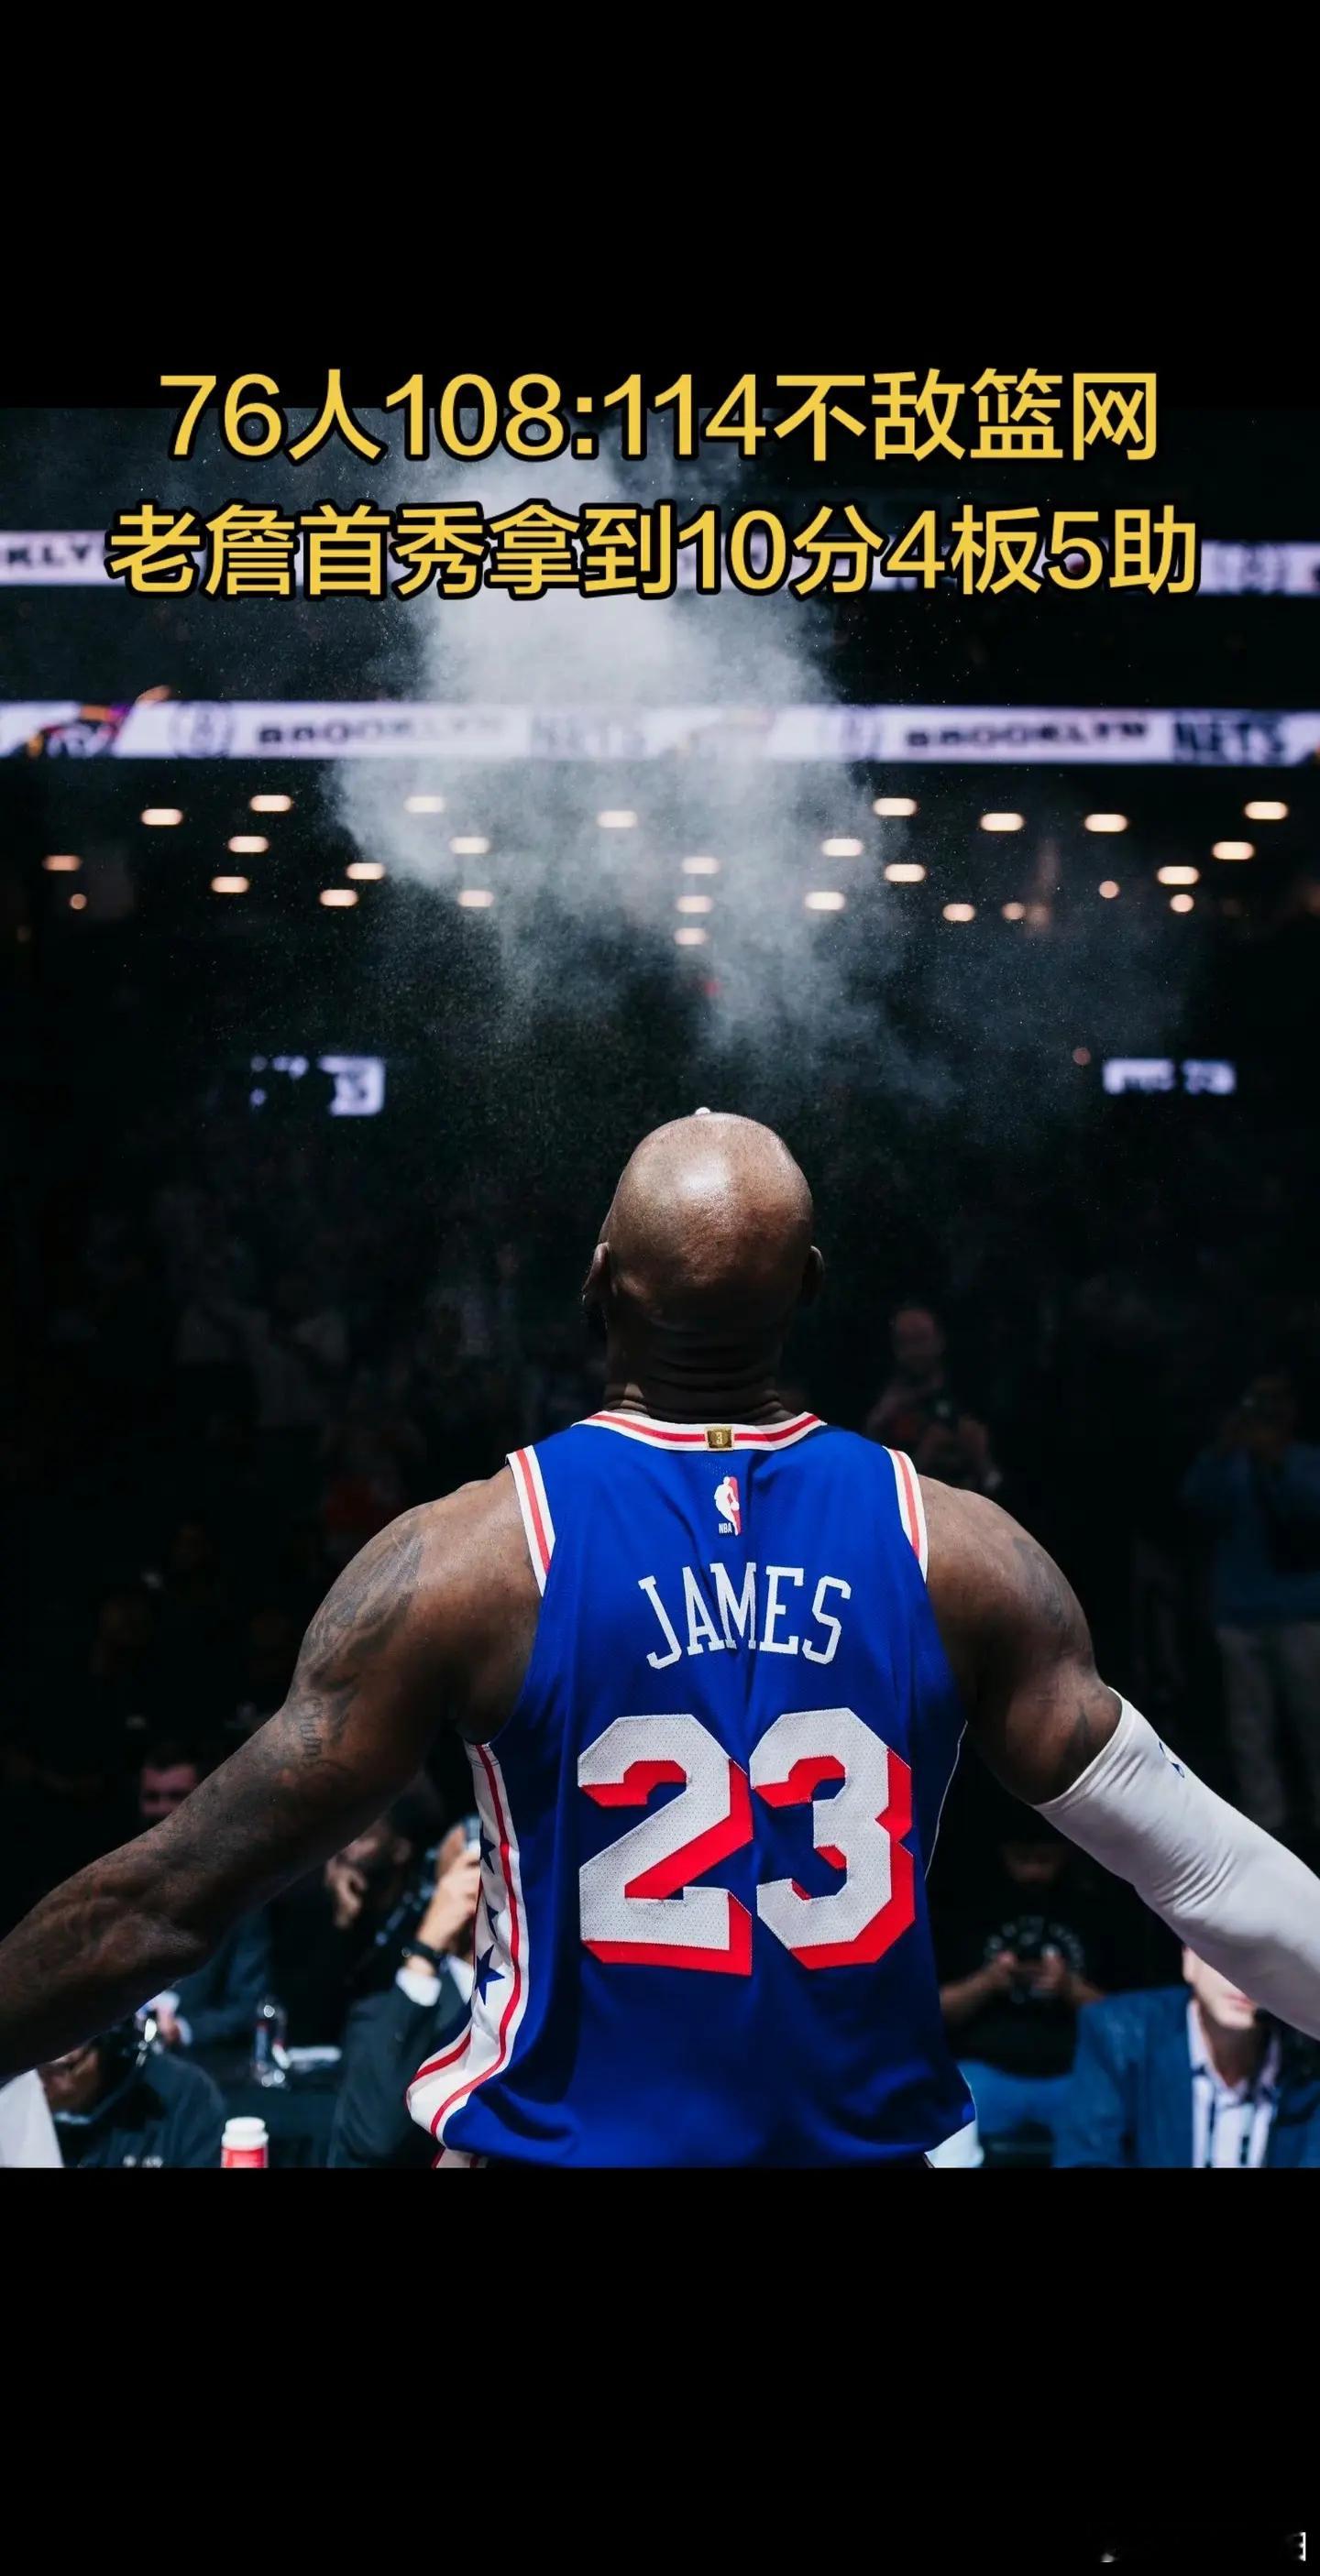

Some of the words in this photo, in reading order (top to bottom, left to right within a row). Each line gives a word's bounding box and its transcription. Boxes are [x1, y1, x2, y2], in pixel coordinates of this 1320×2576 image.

[718, 1521, 732, 1534] NBA
[637, 1562, 852, 1670] JAMES
[577, 1706, 918, 1976] 23
